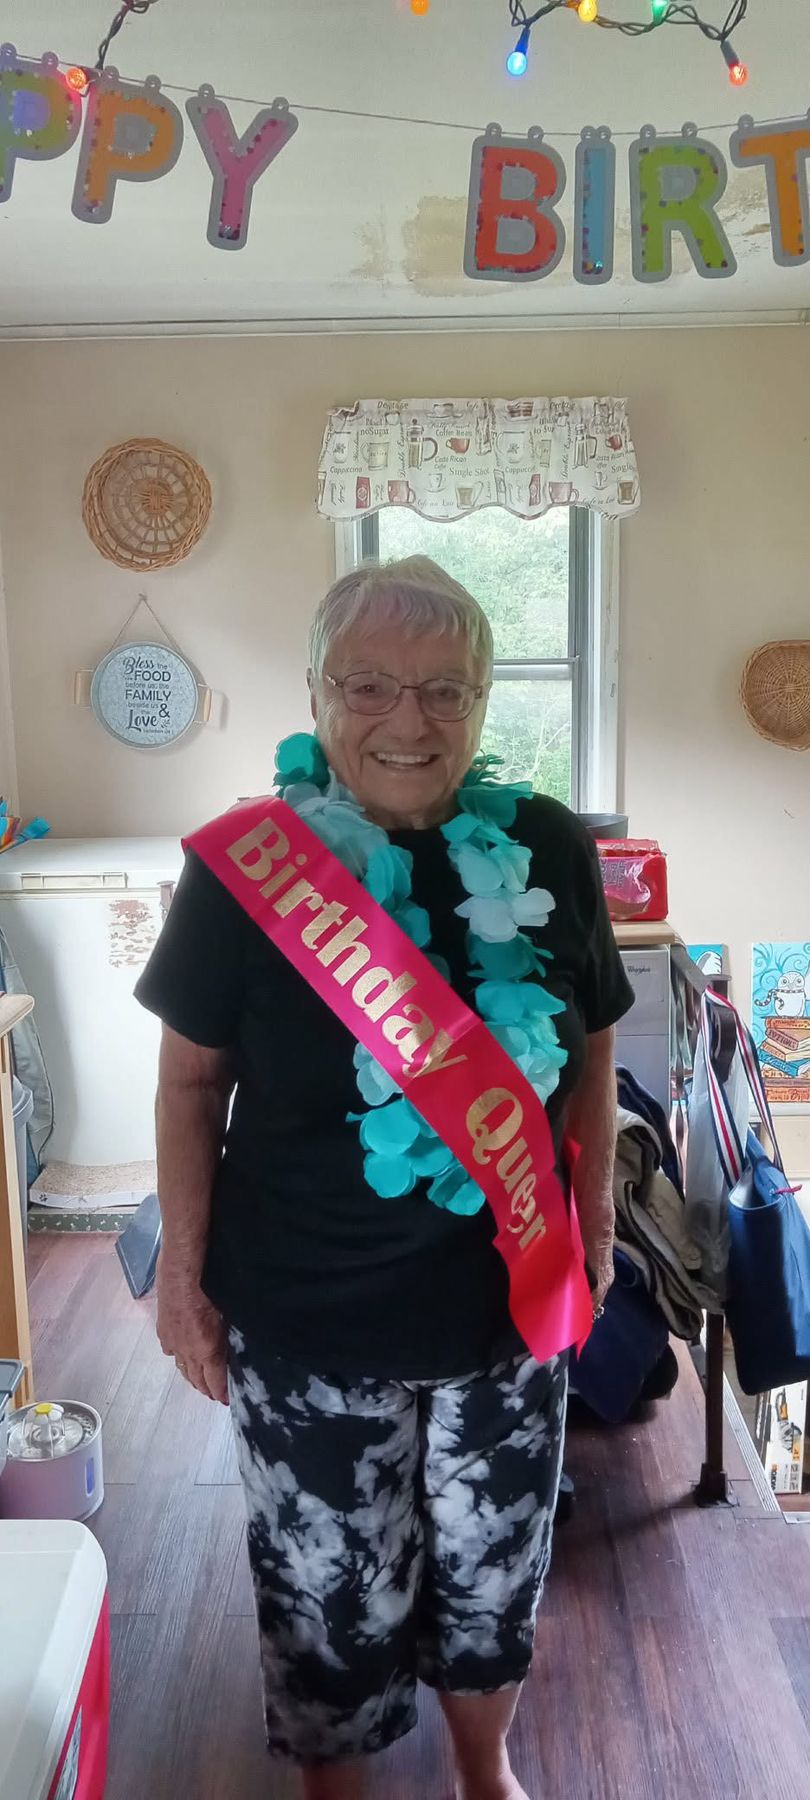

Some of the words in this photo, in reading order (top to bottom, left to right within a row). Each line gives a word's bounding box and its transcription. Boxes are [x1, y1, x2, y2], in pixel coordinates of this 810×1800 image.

[123, 656, 154, 674] Bless
[134, 671, 171, 681] FOOD
[125, 690, 171, 701] FAMILY
[158, 702, 171, 718] &
[126, 709, 159, 731] Love
[226, 817, 467, 1077] Birthday
